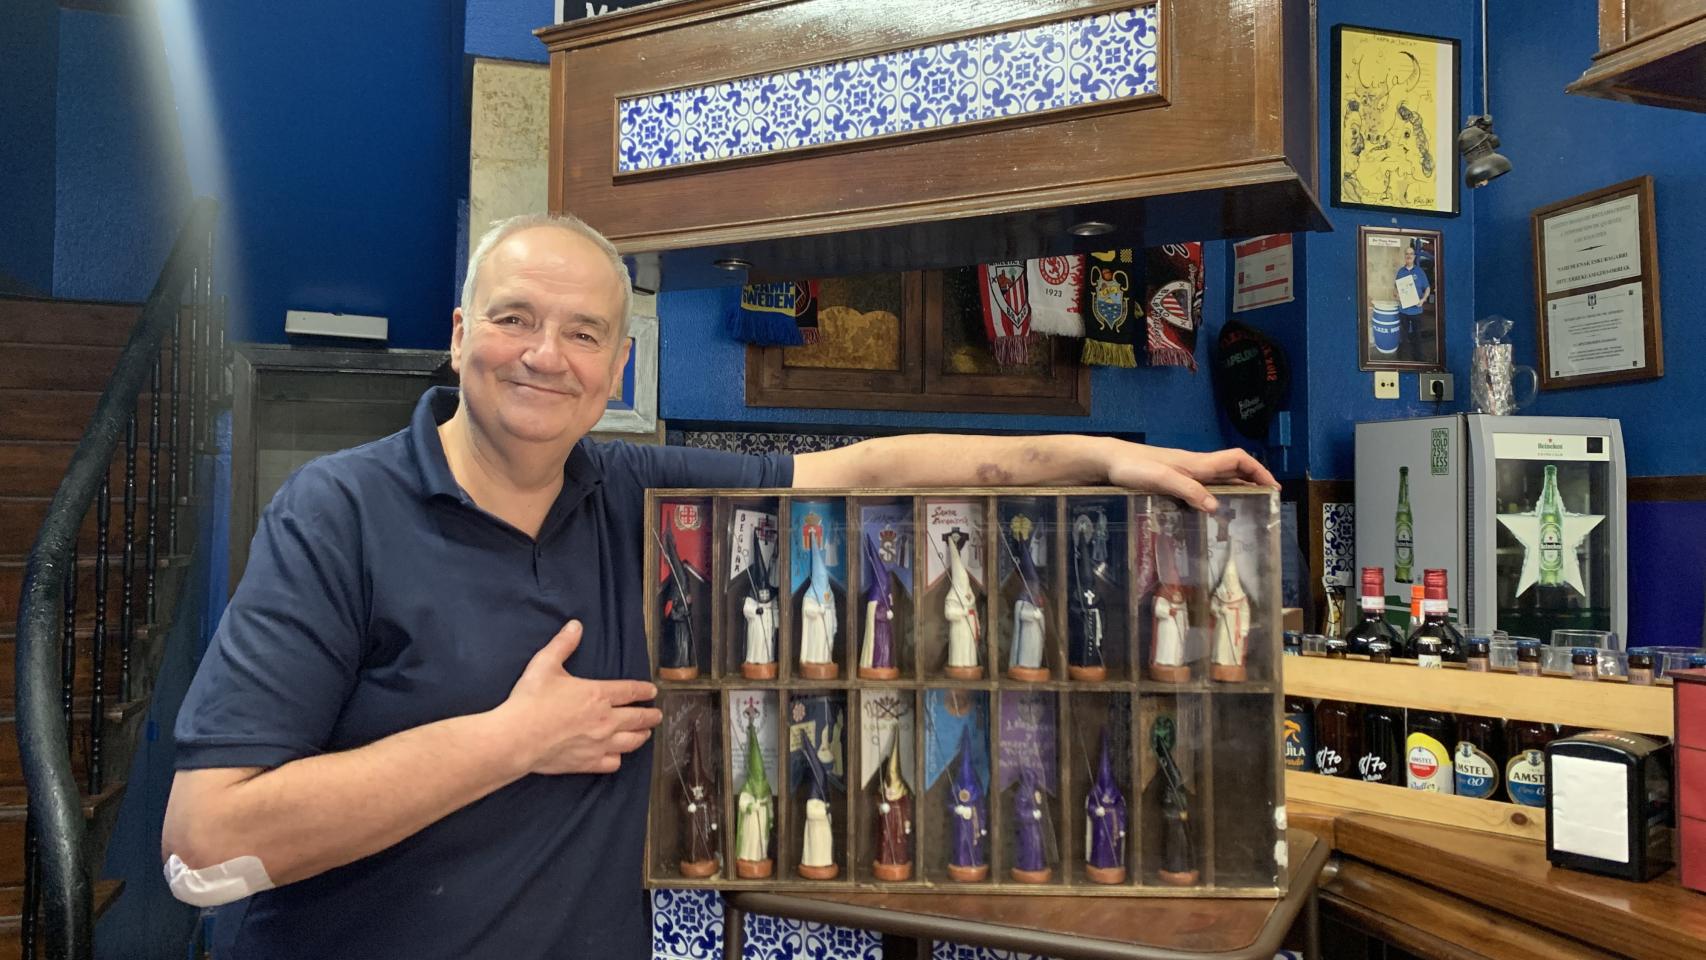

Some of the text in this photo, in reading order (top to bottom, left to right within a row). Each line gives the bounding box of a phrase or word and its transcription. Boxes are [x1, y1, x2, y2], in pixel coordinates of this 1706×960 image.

[742, 289, 795, 309] SWEDEN
[1045, 288, 1062, 298] 1923
[1432, 438, 1448, 447] COLD
[1432, 456, 1448, 468] LESS
[1457, 763, 1488, 775] MSTEL
[1513, 771, 1545, 783] AMST
